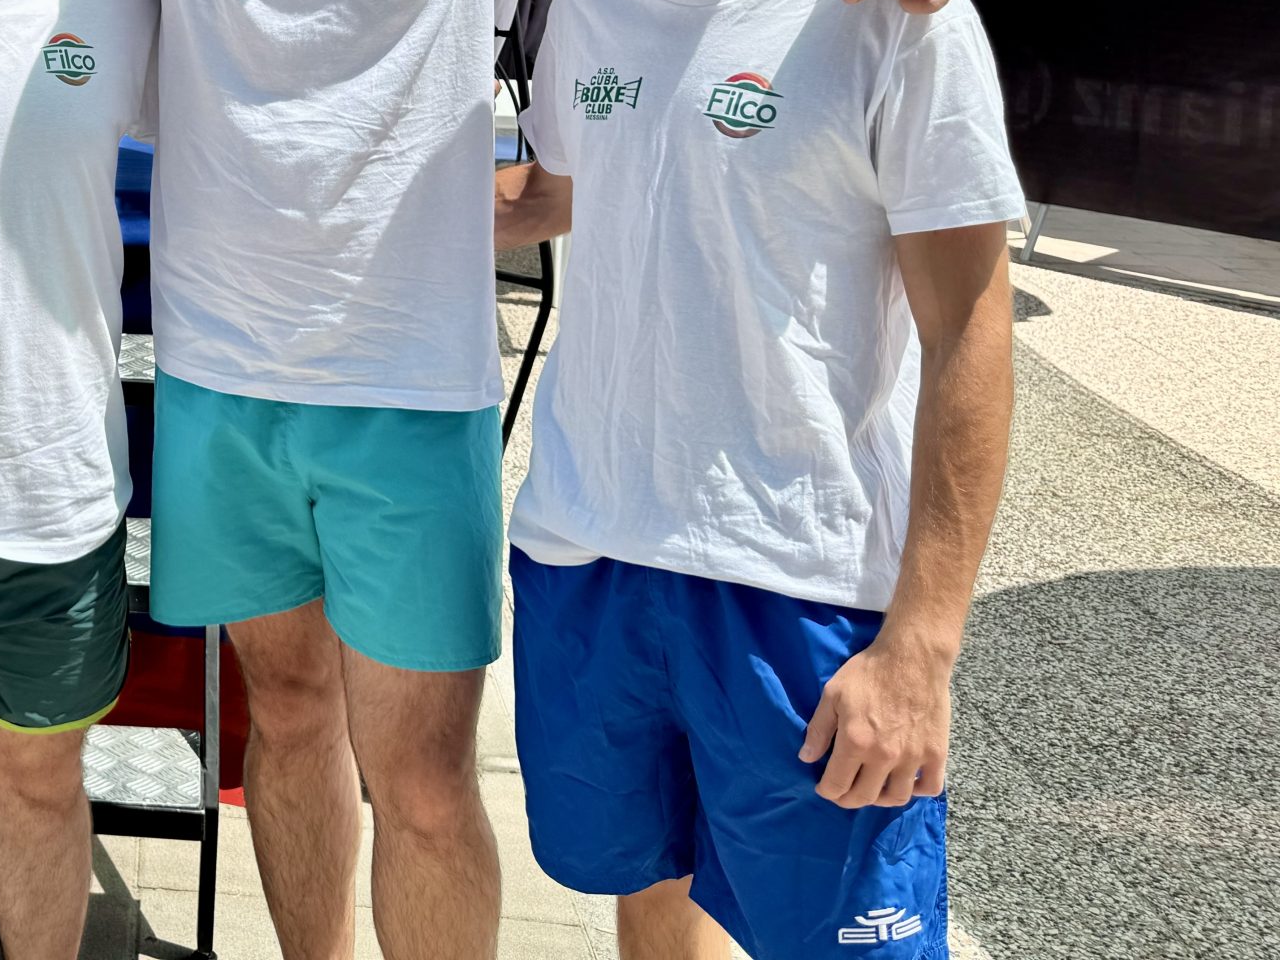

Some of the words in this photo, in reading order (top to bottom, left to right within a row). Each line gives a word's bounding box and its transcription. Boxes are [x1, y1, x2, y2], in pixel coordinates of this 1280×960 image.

[43, 48, 95, 71] Filco
[590, 75, 618, 86] CUBA
[580, 86, 627, 103] BOXE
[585, 103, 612, 114] CLUB
[706, 87, 777, 124] Filco
